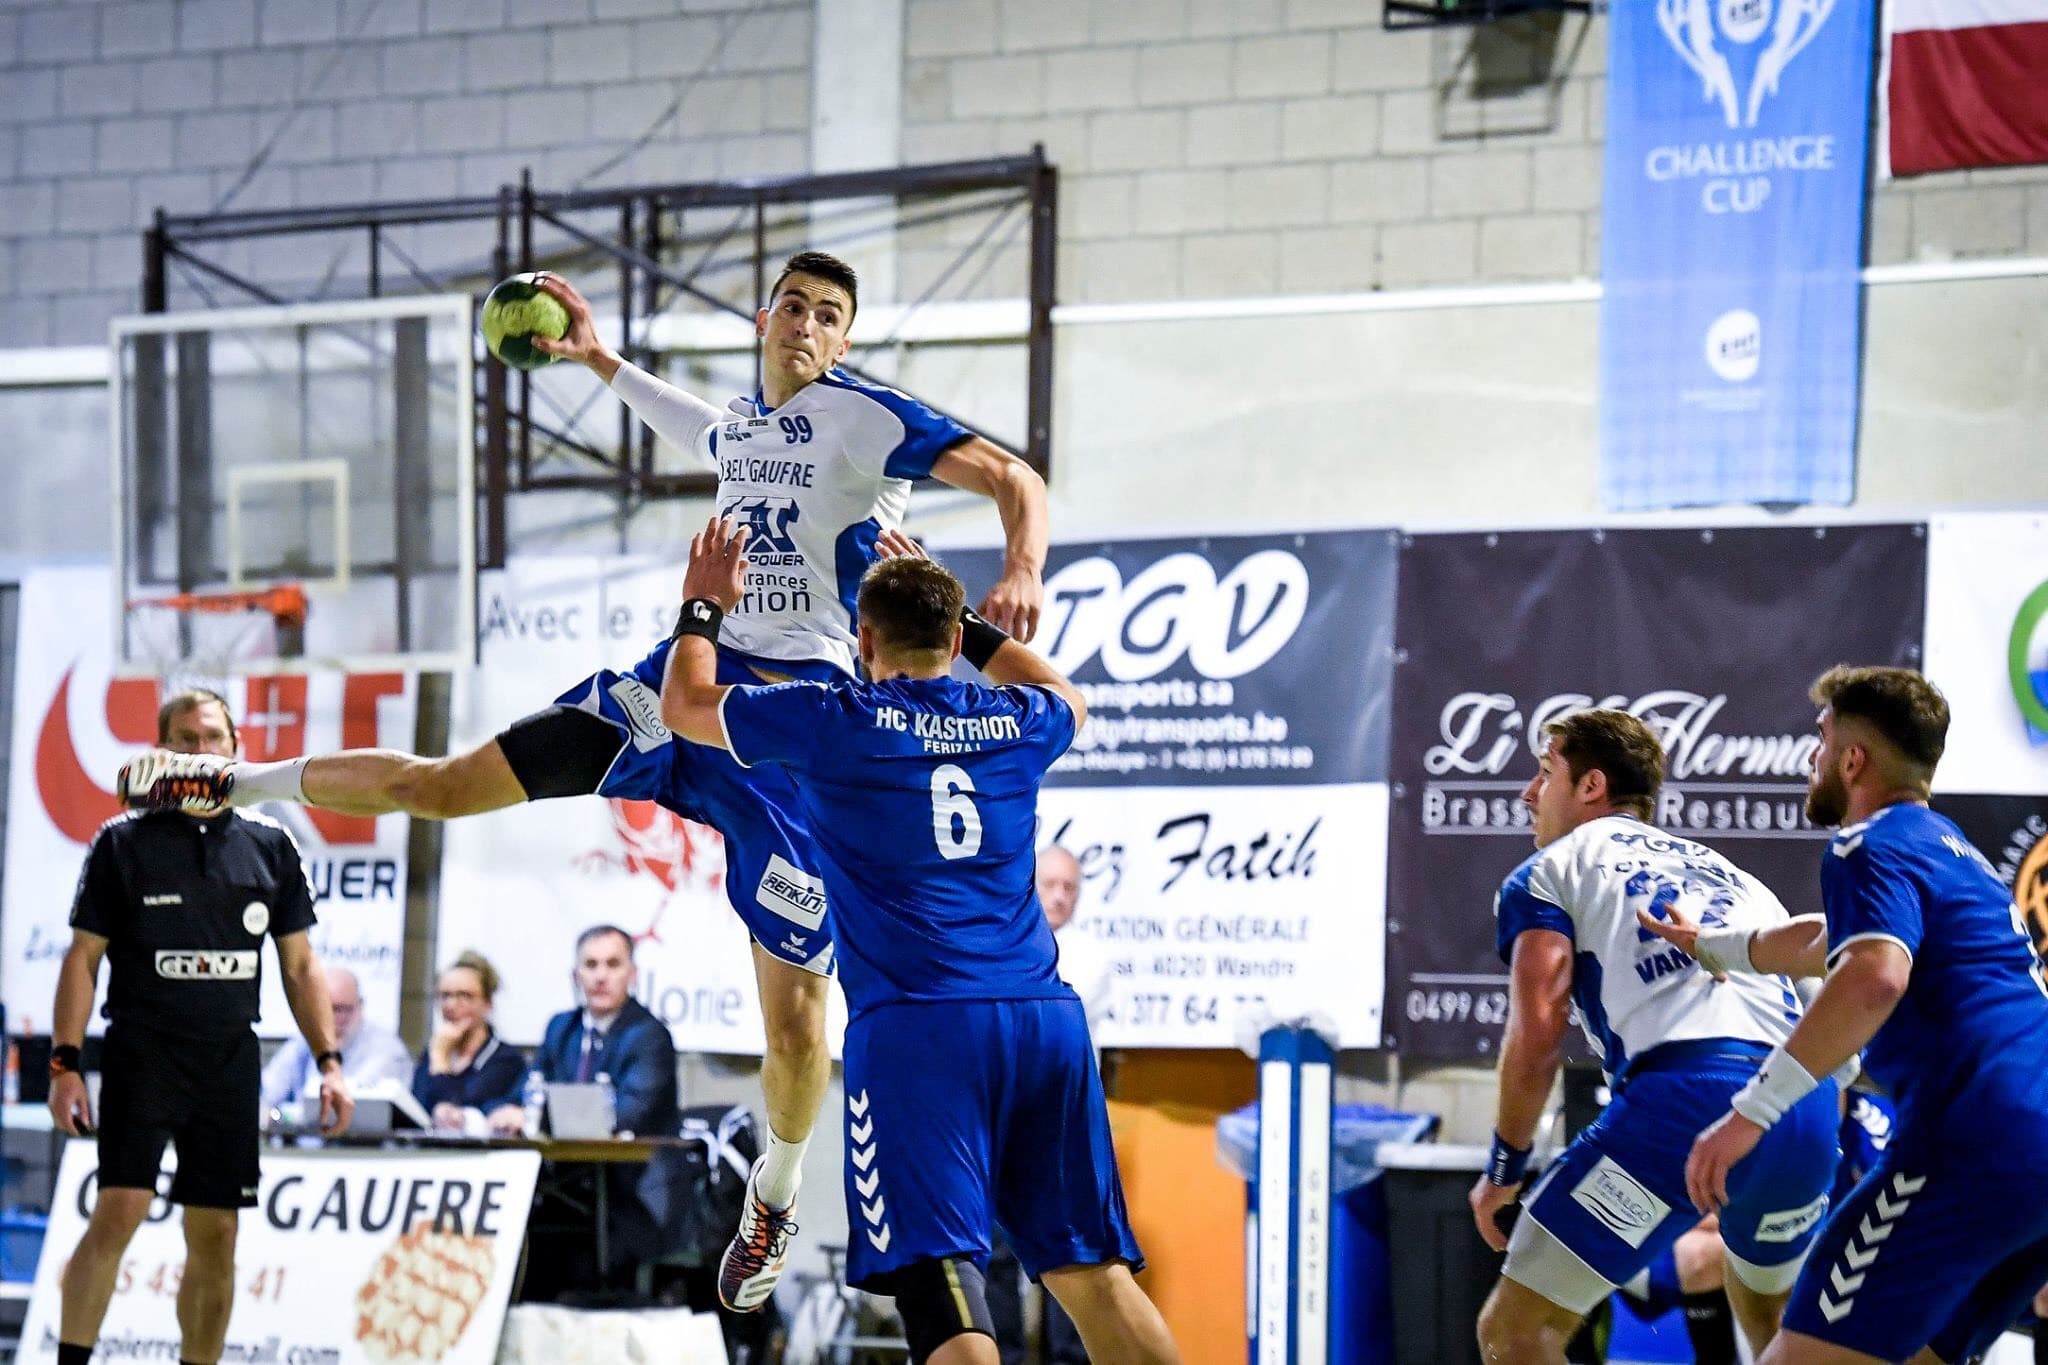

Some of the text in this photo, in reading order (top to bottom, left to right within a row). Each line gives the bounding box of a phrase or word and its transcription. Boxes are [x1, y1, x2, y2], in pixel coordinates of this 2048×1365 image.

[1646, 136, 1836, 182] CHALLENGE
[1701, 177, 1772, 215] CUP
[778, 414, 814, 445] 99
[735, 587, 811, 614] rion
[743, 573, 808, 590] rances
[481, 594, 580, 641] Avec
[1050, 583, 1287, 655] TGV
[876, 706, 907, 732] HC
[930, 763, 983, 861] 6
[1422, 786, 1809, 831] Brass Restau
[1156, 812, 1323, 893] Fatih
[1635, 946, 1693, 985] VAN
